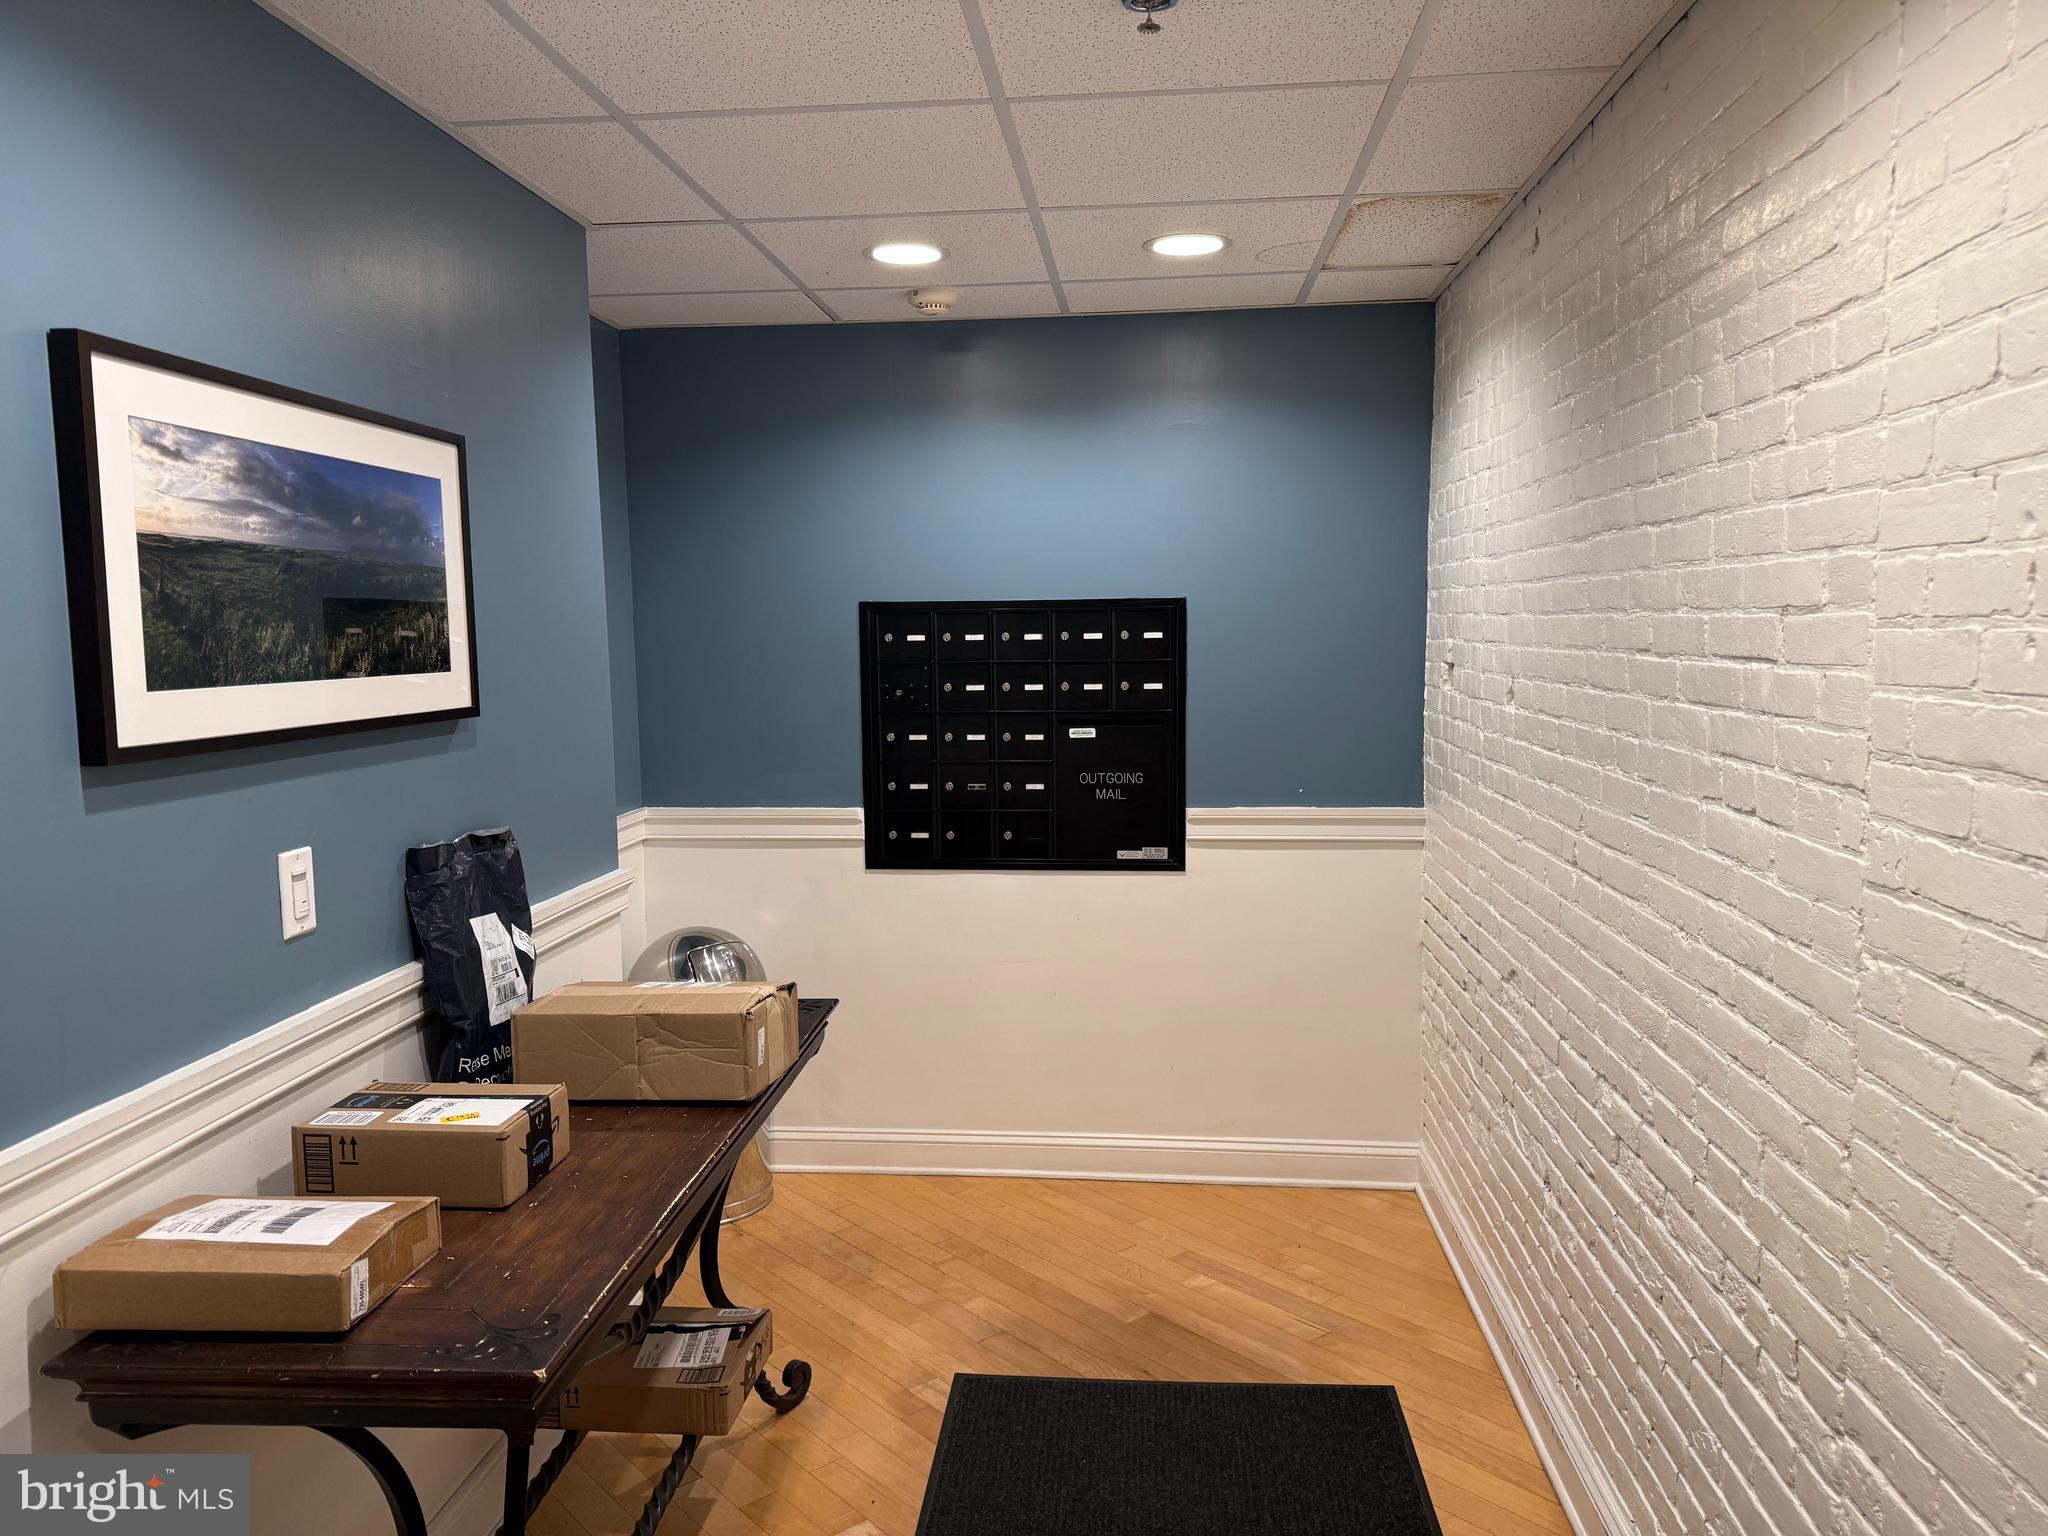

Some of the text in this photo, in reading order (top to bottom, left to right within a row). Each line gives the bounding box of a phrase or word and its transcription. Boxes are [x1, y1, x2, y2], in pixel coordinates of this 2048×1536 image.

[1079, 772, 1144, 784] OUTGOING
[1095, 788, 1127, 800] MAIL
[493, 1044, 512, 1062] Me
